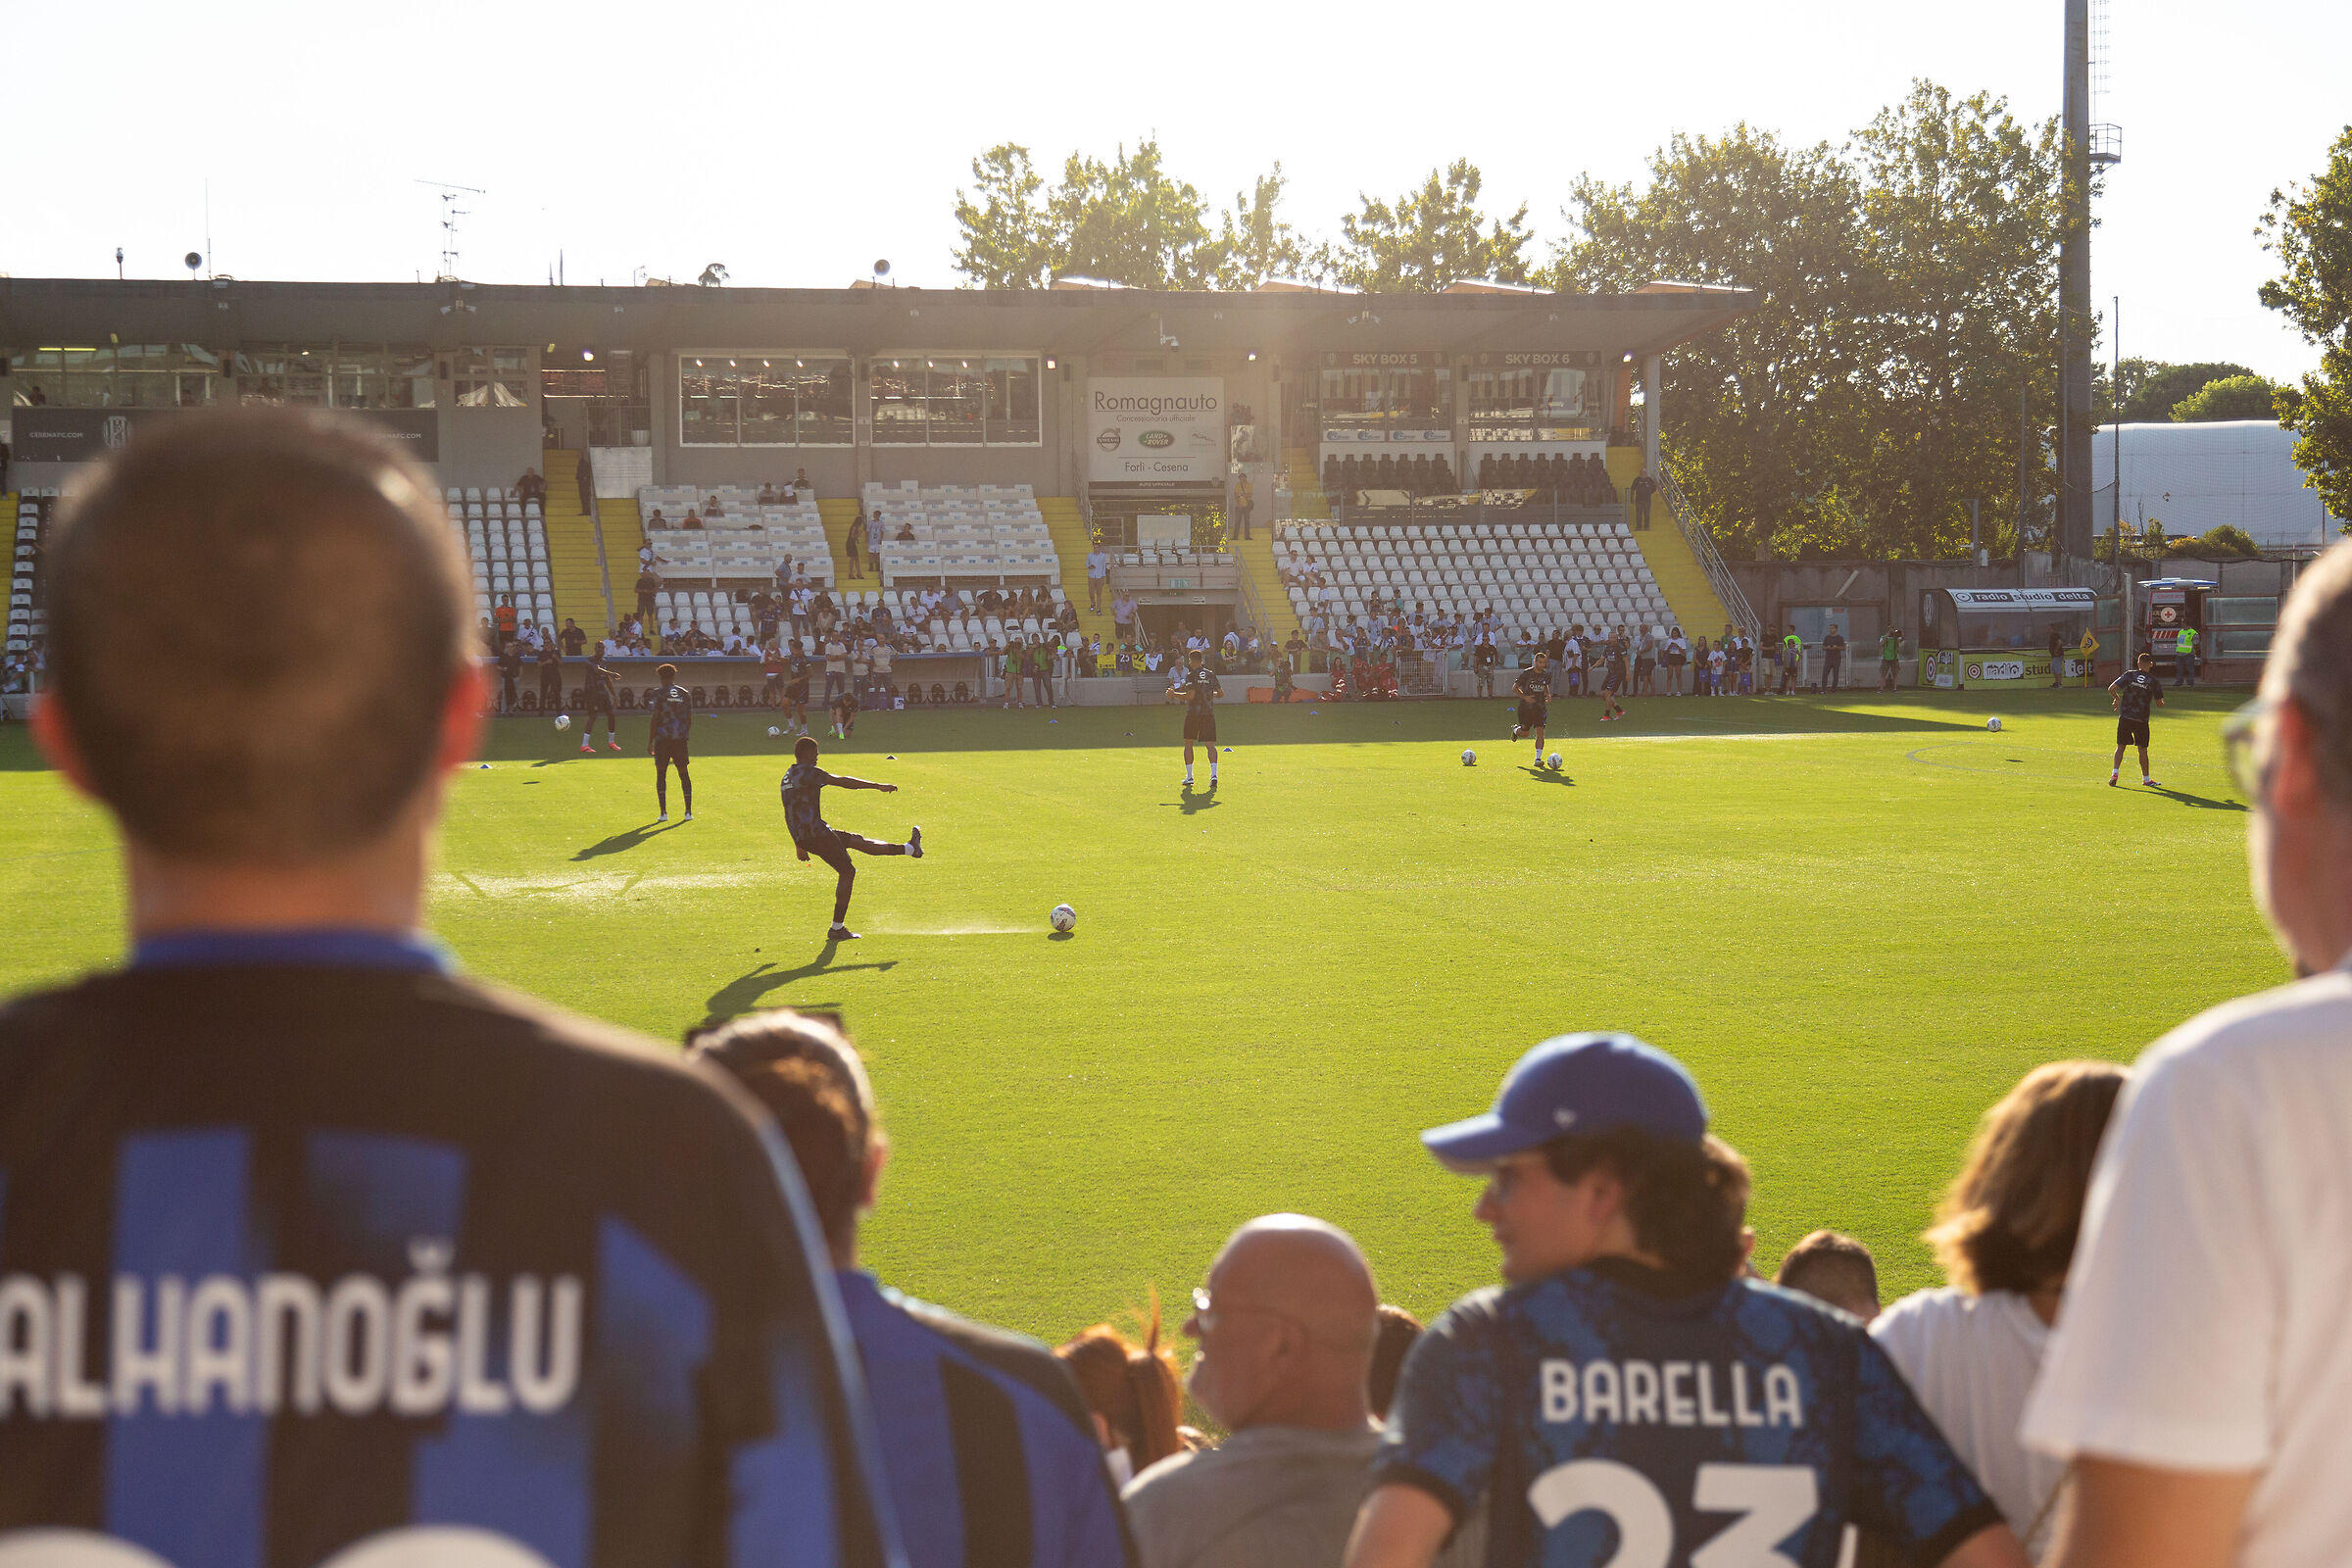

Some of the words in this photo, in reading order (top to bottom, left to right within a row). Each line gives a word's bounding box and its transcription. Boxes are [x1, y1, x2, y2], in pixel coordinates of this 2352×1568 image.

[1352, 354, 1378, 365] SKY
[1380, 354, 1408, 365] BOX
[1409, 354, 1418, 365] 5
[1505, 354, 1531, 365] SKY
[1533, 354, 1559, 365] BOX
[1561, 354, 1570, 365] 6
[1095, 391, 1217, 416] Romagnauto
[1153, 462, 1189, 471] Cesena
[1976, 592, 2008, 601] radio
[2059, 591, 2089, 601] delta
[2025, 663, 2052, 676] stud
[1540, 1358, 1802, 1429] BARELLA
